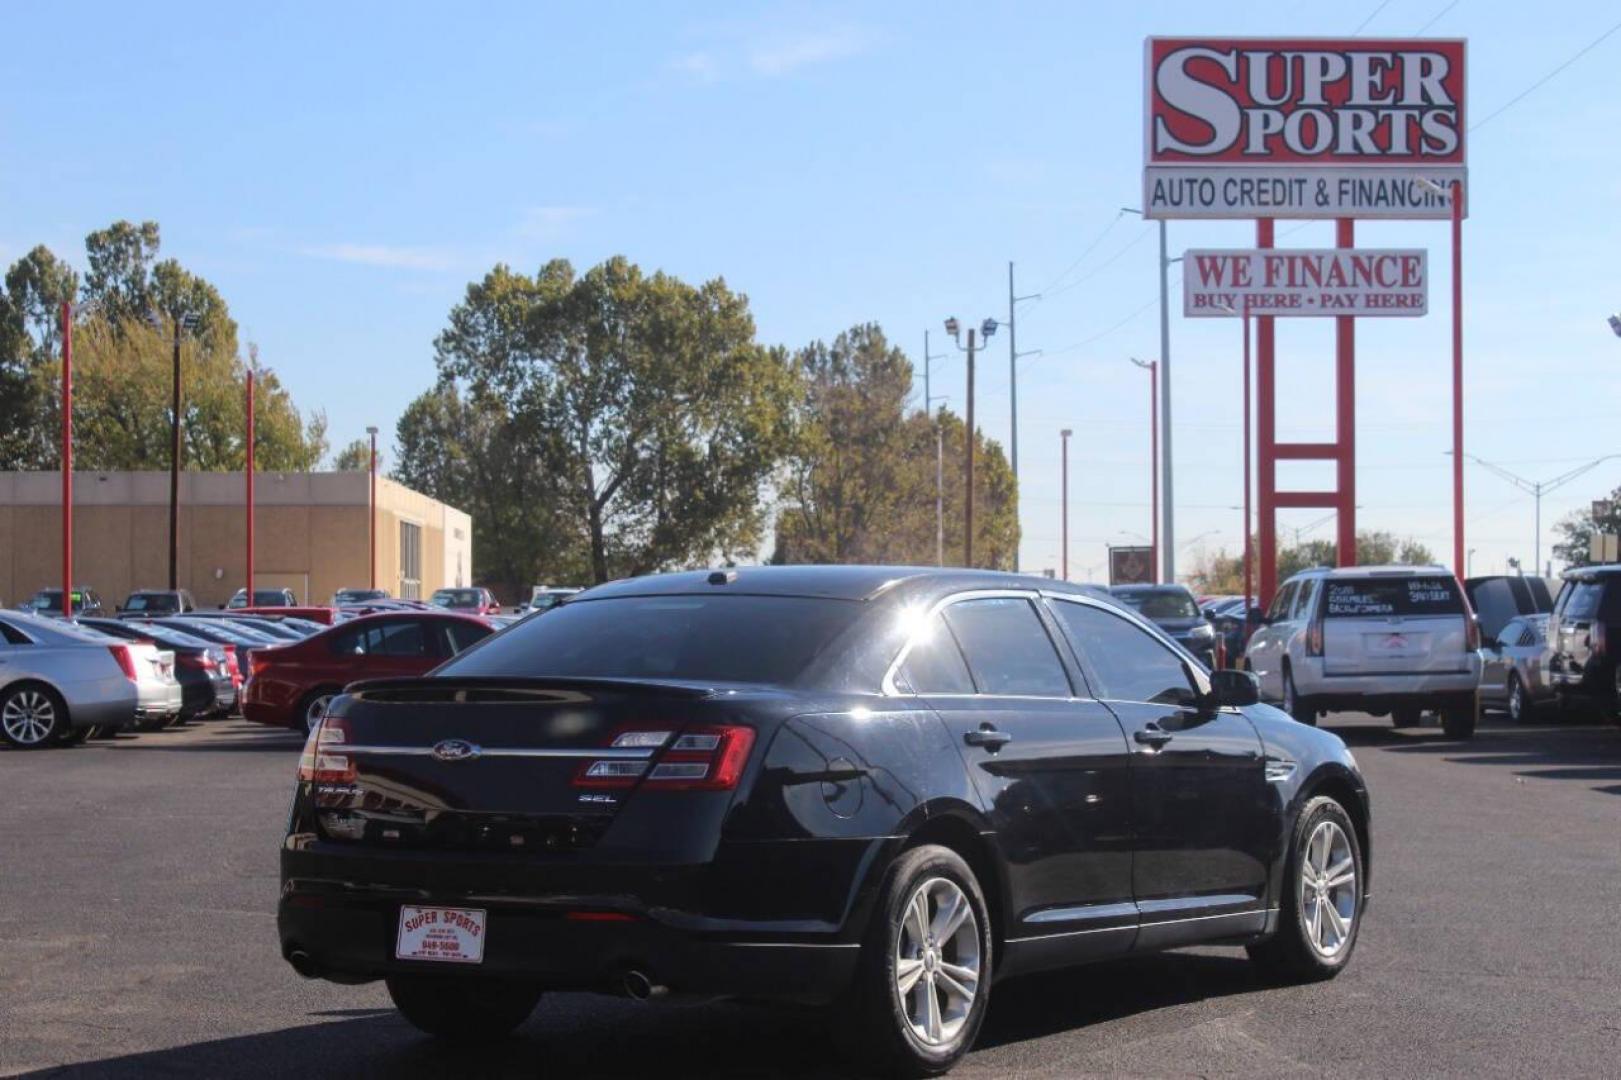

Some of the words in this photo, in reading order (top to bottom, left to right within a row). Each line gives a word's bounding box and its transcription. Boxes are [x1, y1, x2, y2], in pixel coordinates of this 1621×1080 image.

[1155, 46, 1456, 154] SUPER
[1151, 178, 1216, 207] AUTO
[1223, 178, 1307, 207] CREDIT
[1314, 178, 1330, 207] &
[1195, 255, 1252, 288] WE
[1263, 255, 1422, 288] FINANCE
[1193, 293, 1237, 309] BUY
[1244, 293, 1301, 309] HERE
[1320, 293, 1358, 309] PAY
[1366, 293, 1424, 309] HERE
[578, 795, 617, 803] SEL
[405, 911, 437, 932] SUPER
[444, 911, 481, 937] SPORTS
